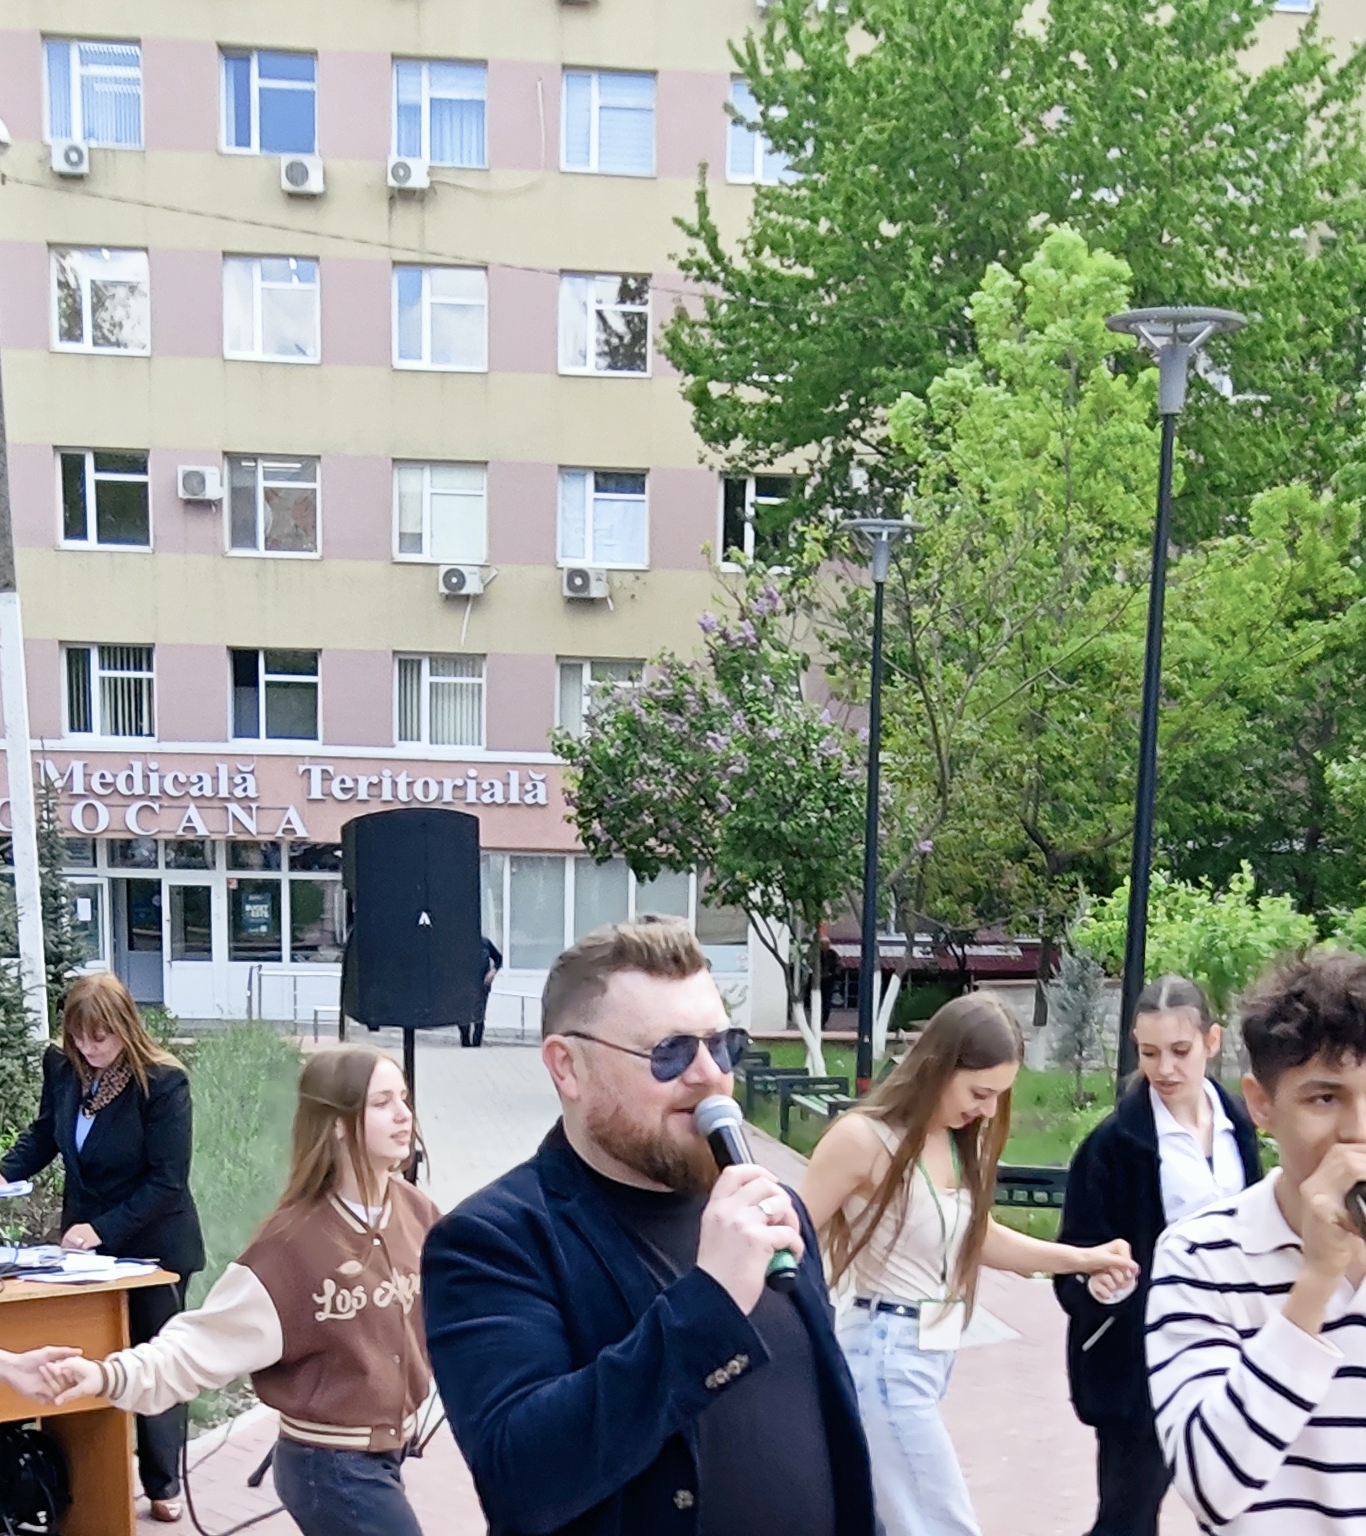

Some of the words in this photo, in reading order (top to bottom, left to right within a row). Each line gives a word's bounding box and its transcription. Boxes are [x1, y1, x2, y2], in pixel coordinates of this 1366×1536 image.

[36, 760, 259, 799] Medicală
[298, 764, 548, 806] Teritorială
[312, 1278, 368, 1321] Los
